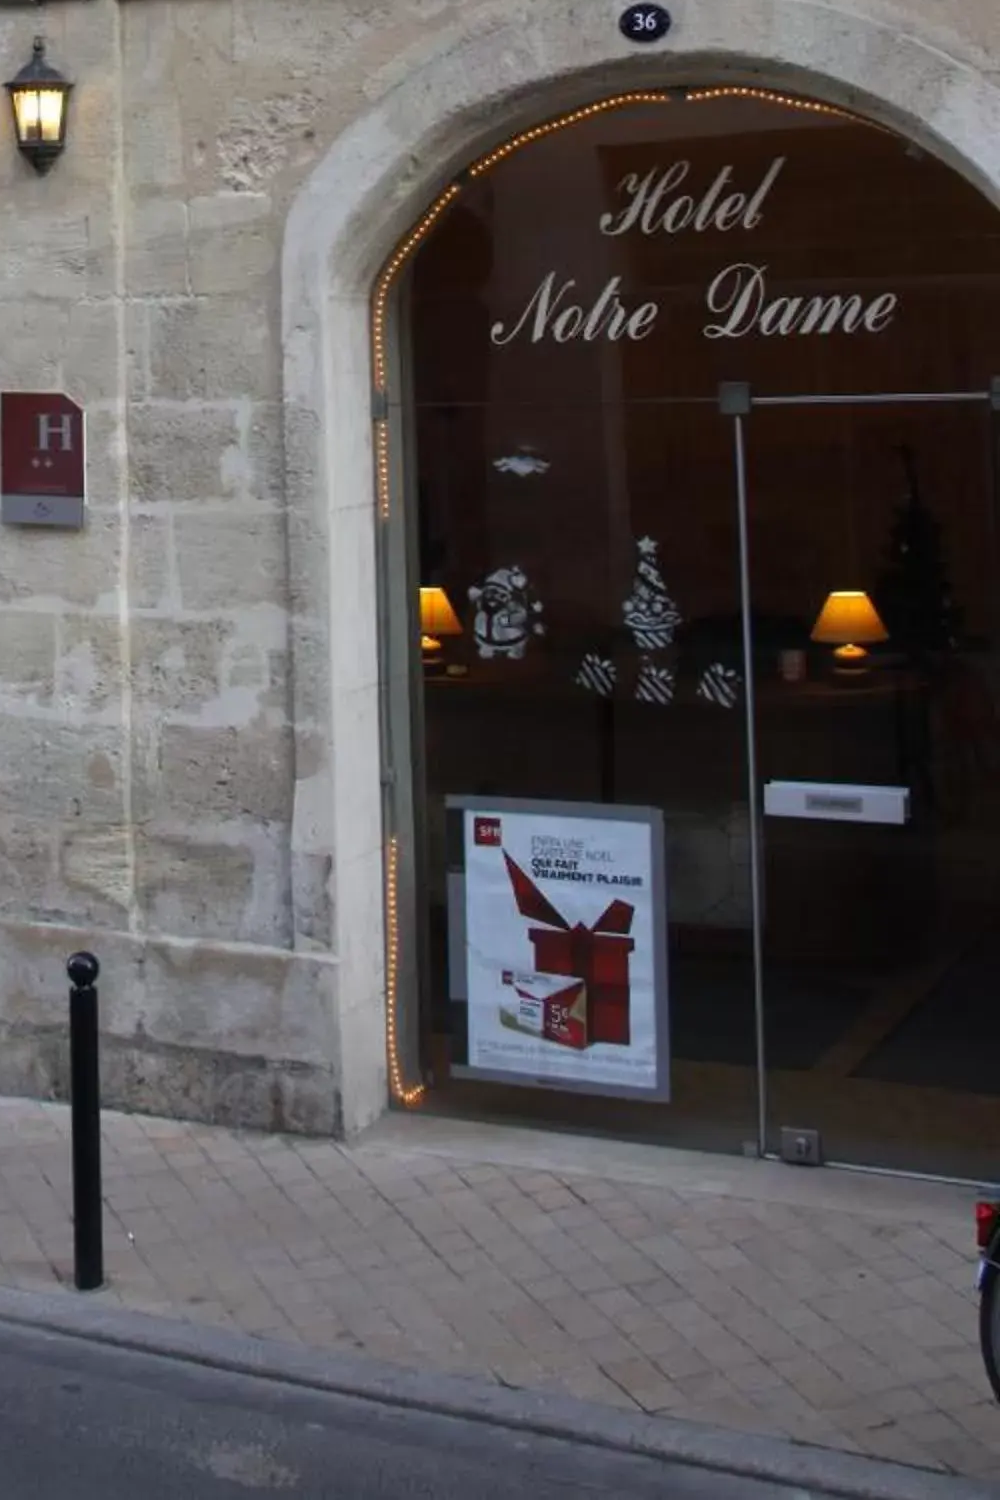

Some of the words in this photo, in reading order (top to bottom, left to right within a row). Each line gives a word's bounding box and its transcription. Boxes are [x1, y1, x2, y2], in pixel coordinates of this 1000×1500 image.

[633, 13, 657, 32] 36
[600, 155, 788, 236] Hotel
[490, 270, 659, 345] Notre
[702, 263, 898, 341] Dame
[39, 414, 72, 450] H
[532, 867, 593, 882] VRAIMENT
[596, 873, 644, 886] PLAISIR
[554, 859, 578, 870] FAIT
